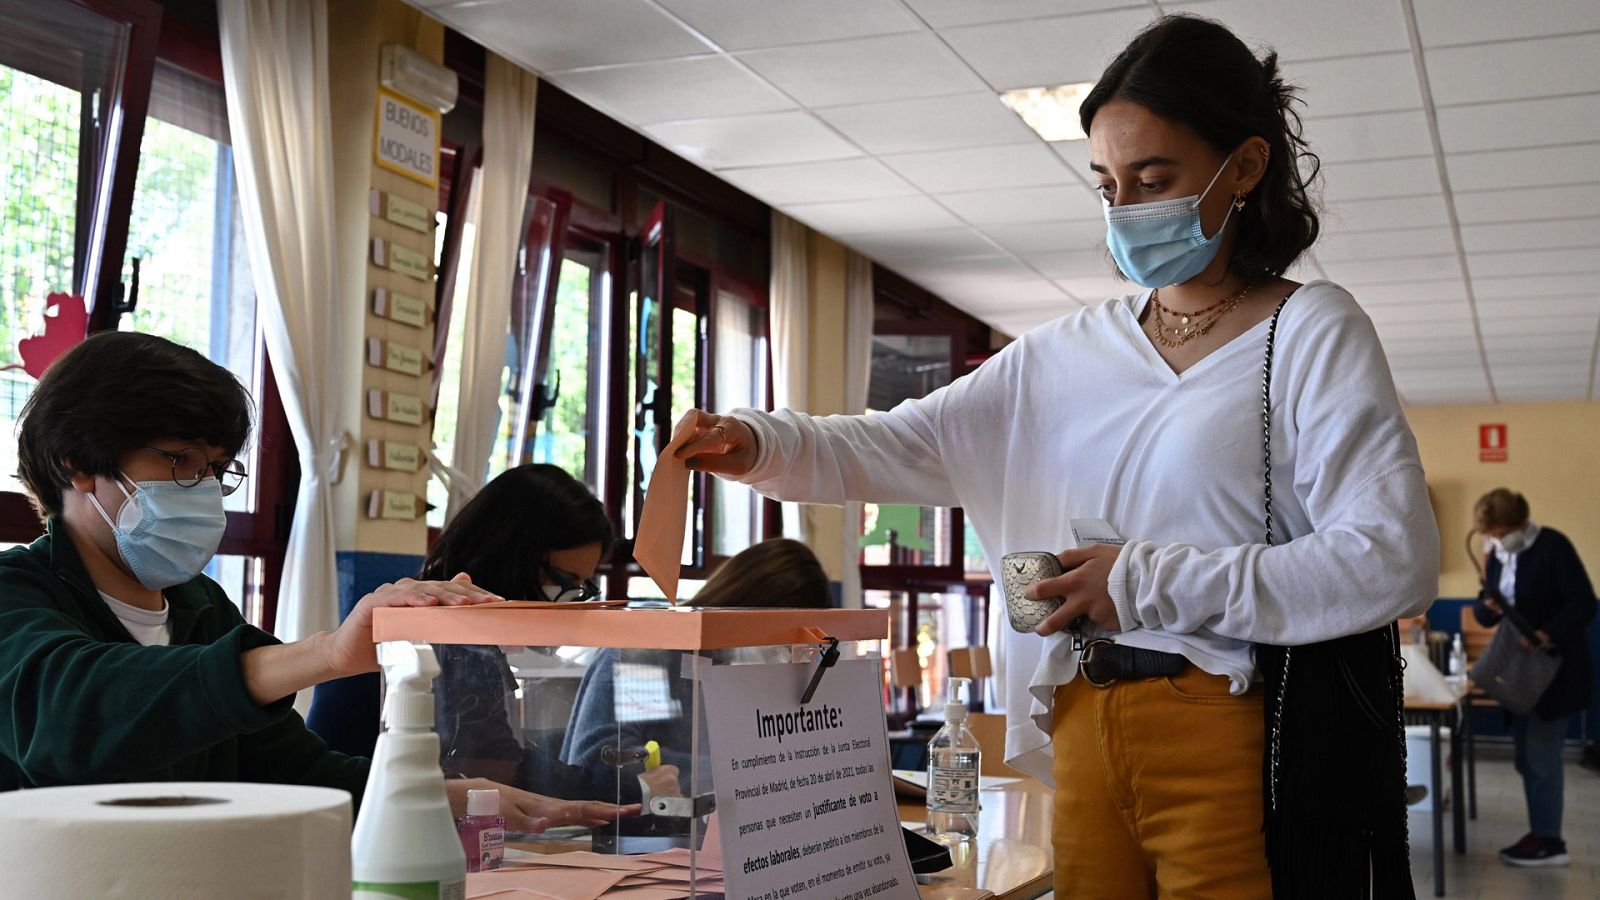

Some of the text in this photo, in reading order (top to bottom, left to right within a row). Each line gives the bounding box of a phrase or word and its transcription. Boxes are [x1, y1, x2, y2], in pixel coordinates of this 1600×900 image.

[385, 100, 429, 137] BUENOS
[380, 135, 432, 174] MODALES
[756, 704, 843, 743] Importante:
[731, 736, 871, 771] En cumplimiento de la Instrucción de la Junta Electoral
[735, 762, 875, 800] Provincial de Madrid, de fecha 20 de abril de 2021, todas las
[738, 791, 879, 838] personas que necesiten un justificante de voto a
[743, 856, 769, 874] efectos
[801, 840, 822, 857] deberán
[822, 835, 840, 853] pedirlo
[839, 836, 844, 846] a
[842, 832, 852, 844] los
[850, 827, 873, 842] miembros
[872, 823, 880, 836] de
[879, 822, 885, 834] la
[772, 888, 779, 900] la
[779, 886, 790, 900] que
[790, 881, 808, 894] voten,
[807, 878, 816, 889] en
[815, 873, 821, 886] el
[821, 867, 846, 883] momento
[845, 864, 853, 876] de
[852, 859, 867, 874] emitir
[866, 859, 873, 869] su
[884, 852, 891, 864] ya
[862, 887, 872, 898] vez
[871, 876, 899, 895] abandonado
